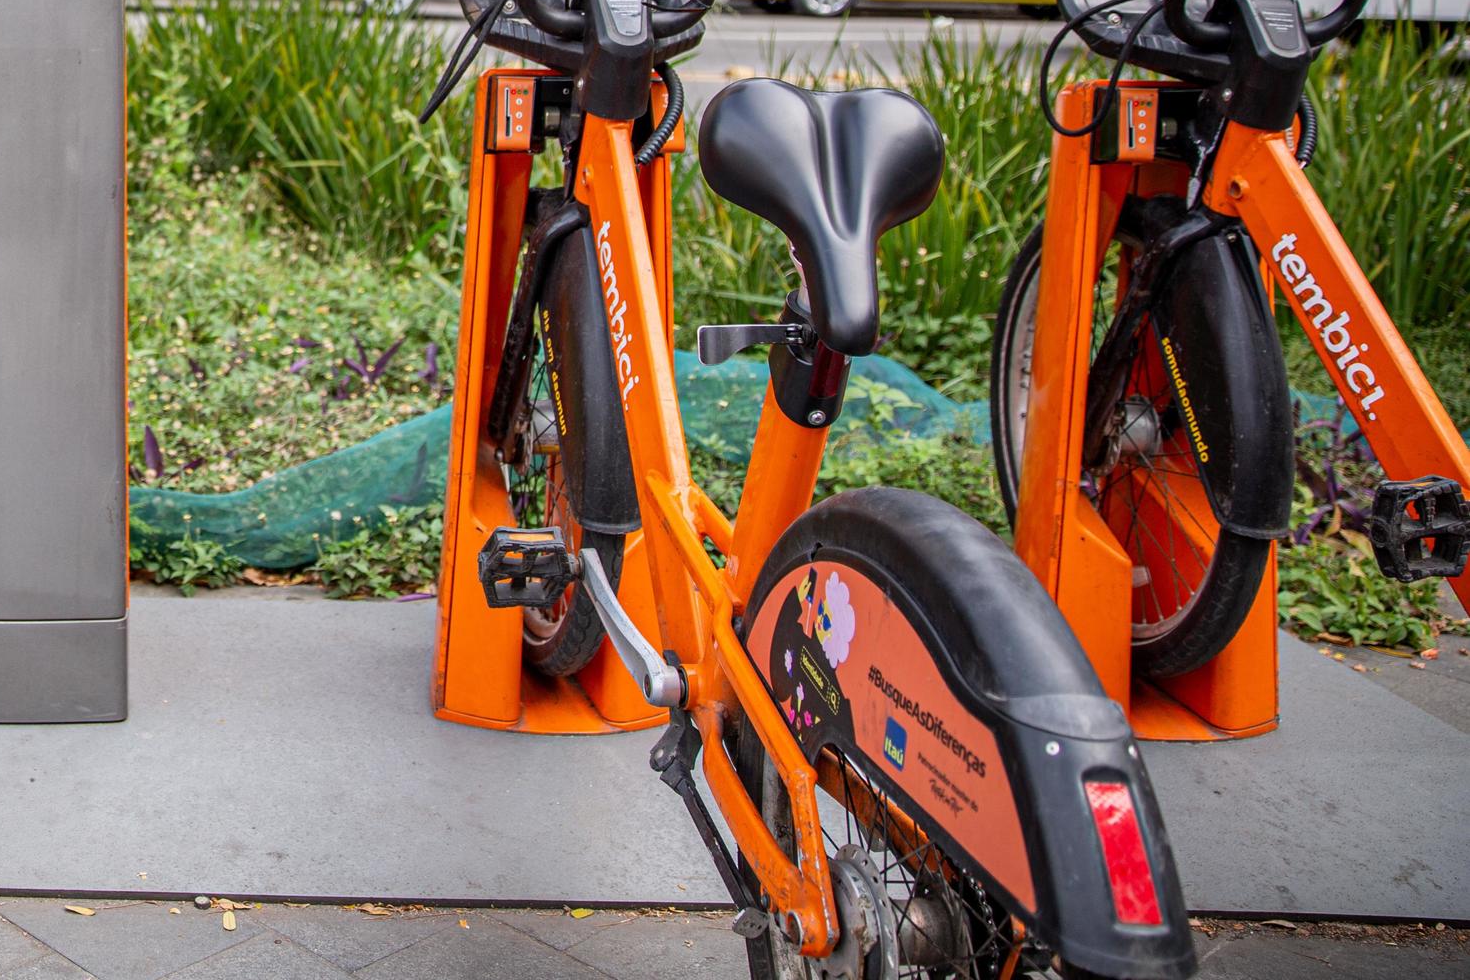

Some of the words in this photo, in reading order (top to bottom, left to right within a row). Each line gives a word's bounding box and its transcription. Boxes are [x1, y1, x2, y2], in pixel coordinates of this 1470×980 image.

[597, 221, 640, 411] tembici.
[1272, 233, 1385, 421] tembici.
[868, 664, 987, 779] #BusqueAsDiferenças
[884, 736, 904, 766] Itaú
